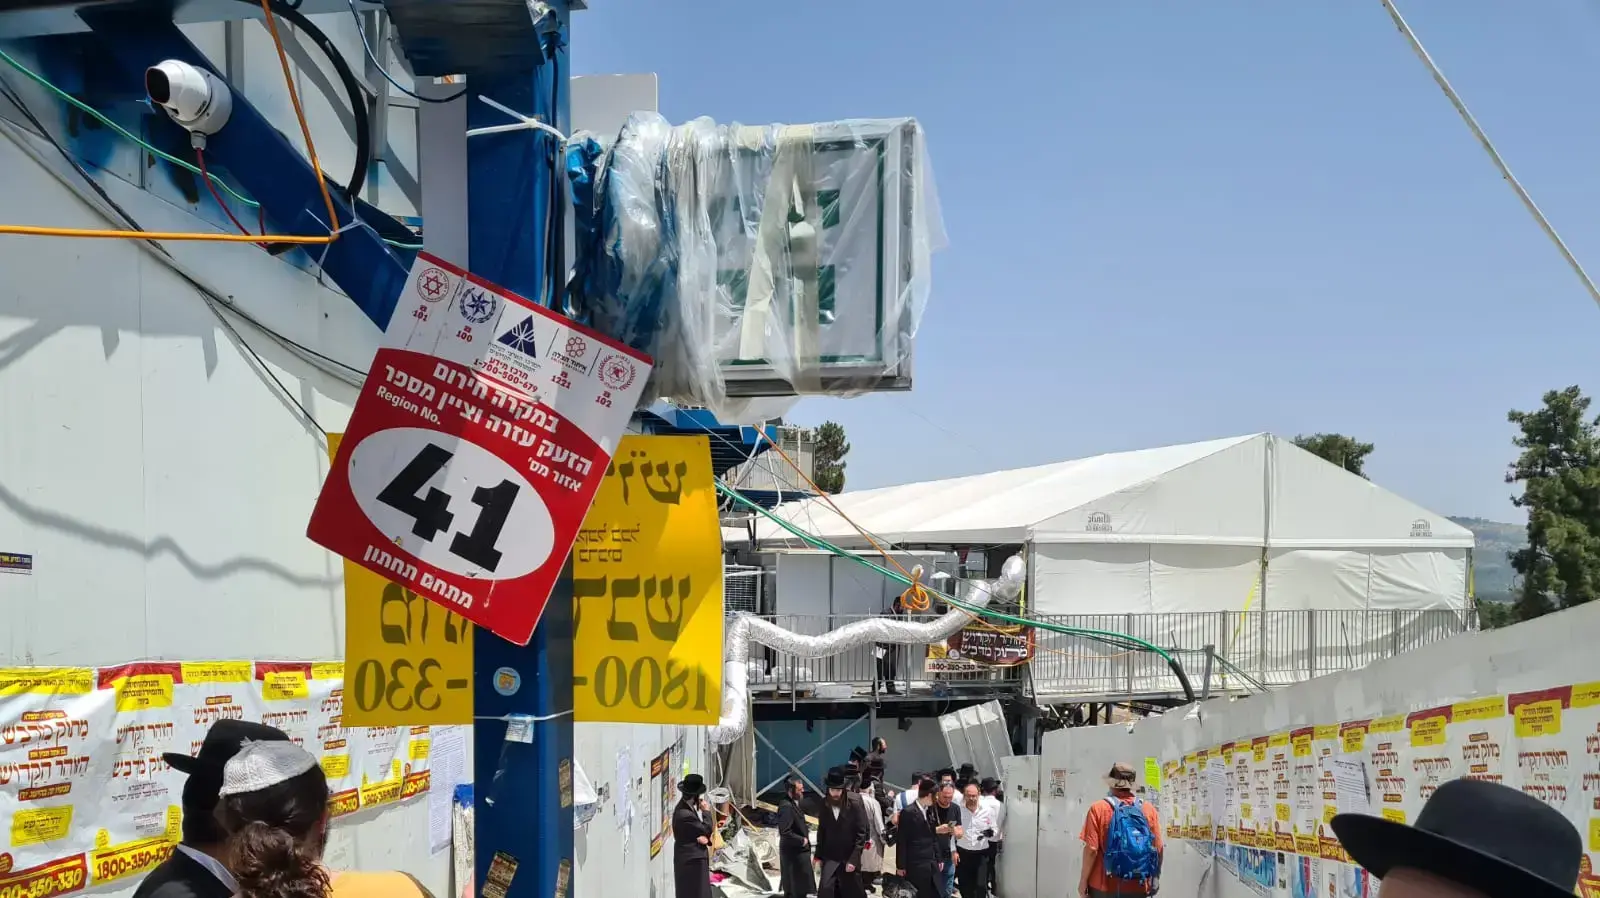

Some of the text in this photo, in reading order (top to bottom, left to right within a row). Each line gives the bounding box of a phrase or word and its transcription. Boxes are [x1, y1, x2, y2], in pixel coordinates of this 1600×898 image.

[412, 310, 428, 322] 101
[456, 330, 472, 342] 100
[488, 356, 529, 380] מרכז מידע
[551, 351, 570, 364] הצלה
[473, 358, 538, 393] 1-700-500-679
[551, 375, 572, 390] 1221
[376, 386, 441, 426] Region No.
[432, 362, 560, 434] במקרה חירום
[595, 396, 612, 408] 102
[384, 364, 594, 476] הזעק עזרה וציין מספר
[527, 457, 582, 492] אזור מס'
[376, 442, 520, 573] 41
[363, 544, 474, 609] מתחם תחתון
[960, 644, 1028, 661] מתוק מדבש
[2, 720, 88, 746] מתוק מדבש
[112, 756, 171, 780] תוק מדבש
